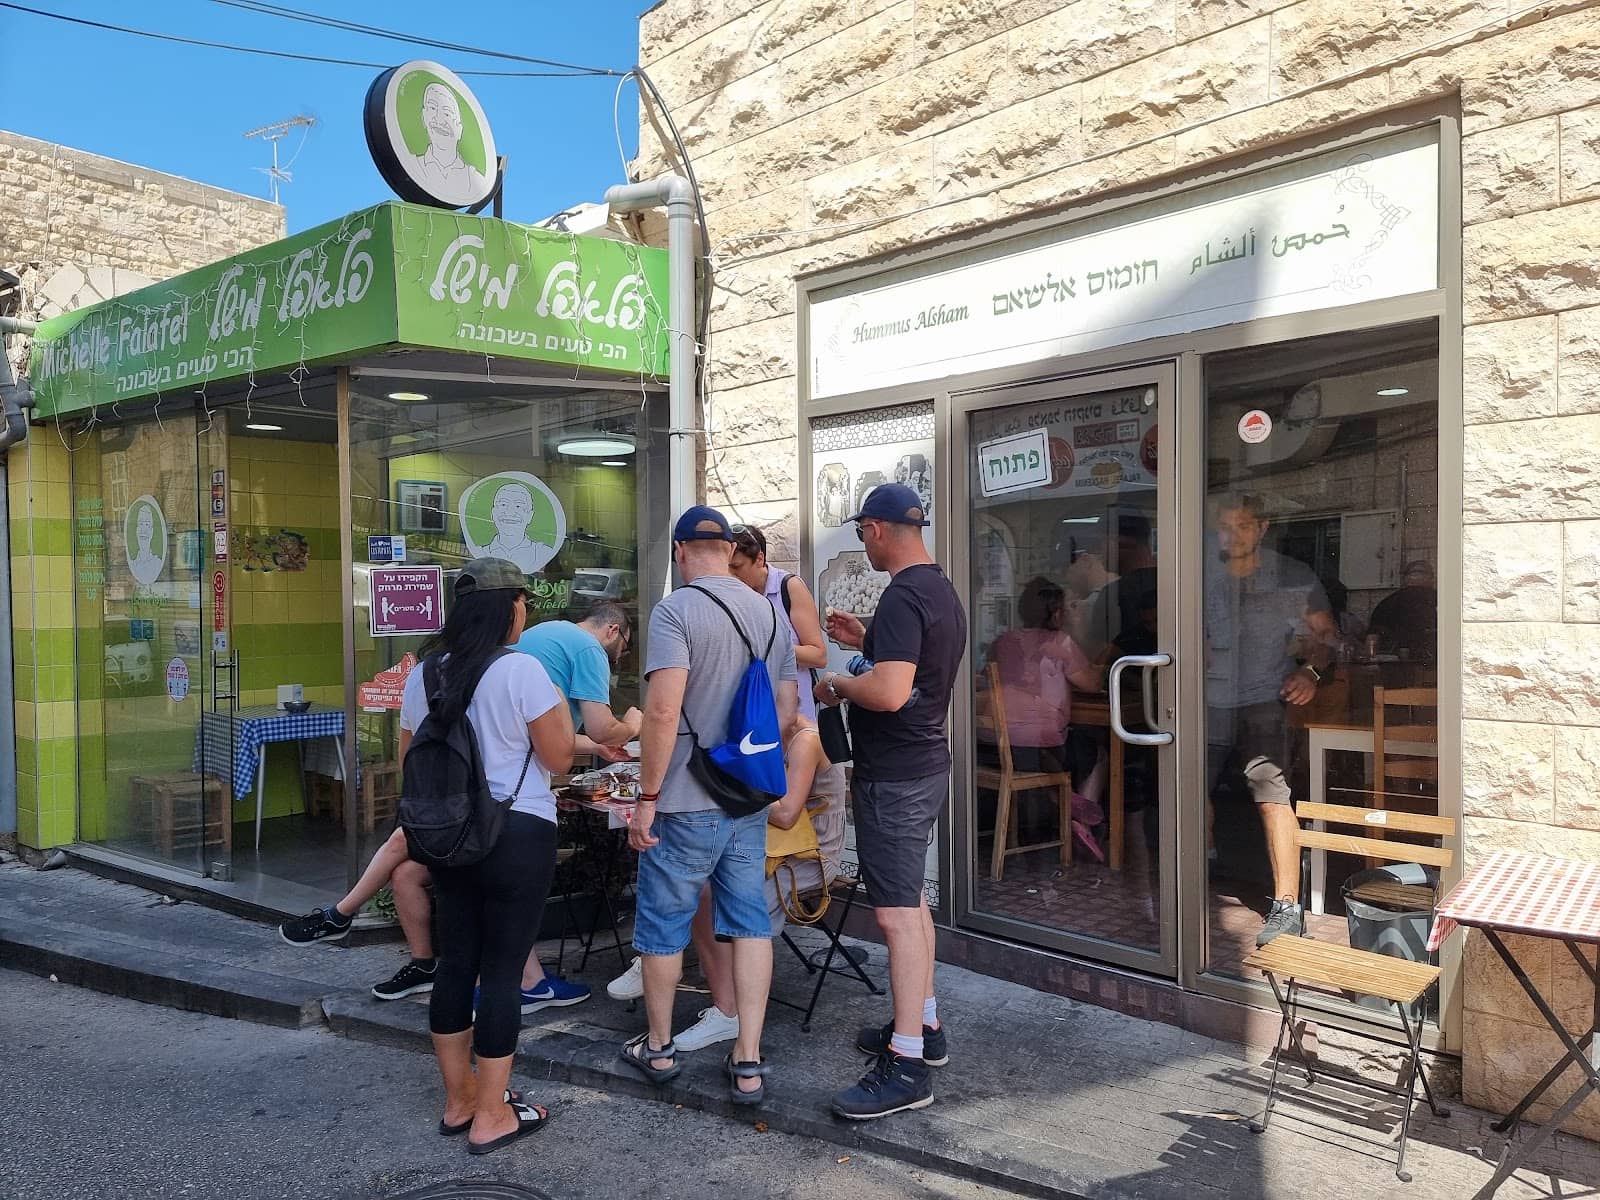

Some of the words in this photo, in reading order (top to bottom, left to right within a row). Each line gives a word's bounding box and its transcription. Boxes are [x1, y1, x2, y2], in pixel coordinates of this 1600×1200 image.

[278, 228, 374, 323] פלאפל
[430, 234, 519, 310] מישל
[1086, 259, 1158, 296] חומוס
[208, 264, 266, 342] מישל
[536, 261, 647, 331] פלאפל
[992, 272, 1076, 316] אלשאם
[458, 322, 539, 349] בשכונה
[852, 318, 911, 344] Hummus
[914, 303, 970, 331] Alsham
[39, 323, 111, 382] Michelle
[117, 298, 189, 361] Falafel
[545, 334, 593, 355] טעים
[598, 342, 627, 361] הכי
[175, 354, 218, 380] טעים
[223, 345, 253, 370] הכי
[117, 365, 171, 394] בשכונה
[988, 448, 1040, 479] פתוח
[378, 584, 403, 593] מרחק
[383, 573, 396, 582] על
[397, 573, 428, 583] הקפידו
[404, 583, 434, 591] שמירת
